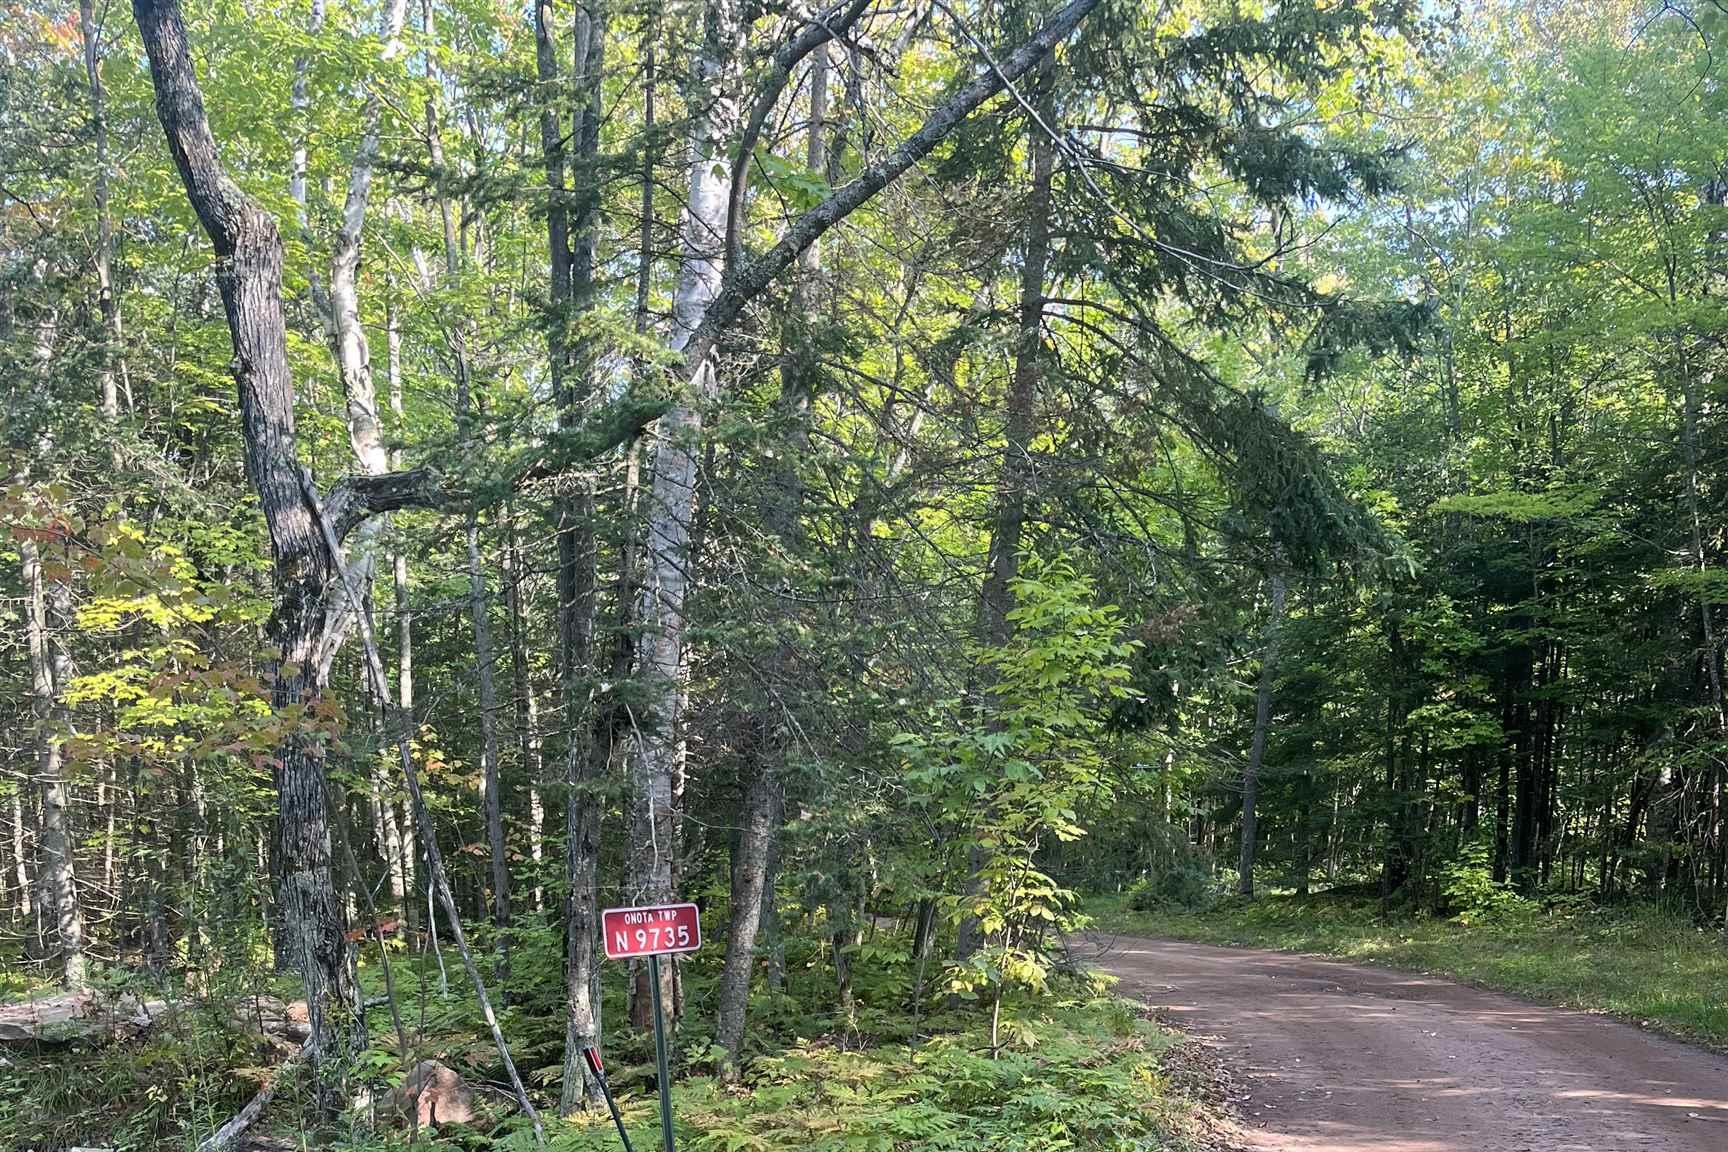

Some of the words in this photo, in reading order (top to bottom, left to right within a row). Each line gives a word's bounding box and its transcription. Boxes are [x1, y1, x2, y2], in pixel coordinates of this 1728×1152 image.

[624, 912, 654, 925] ONOTA
[658, 910, 677, 921] TWP
[615, 930, 629, 952] N
[635, 925, 690, 949] 9735
